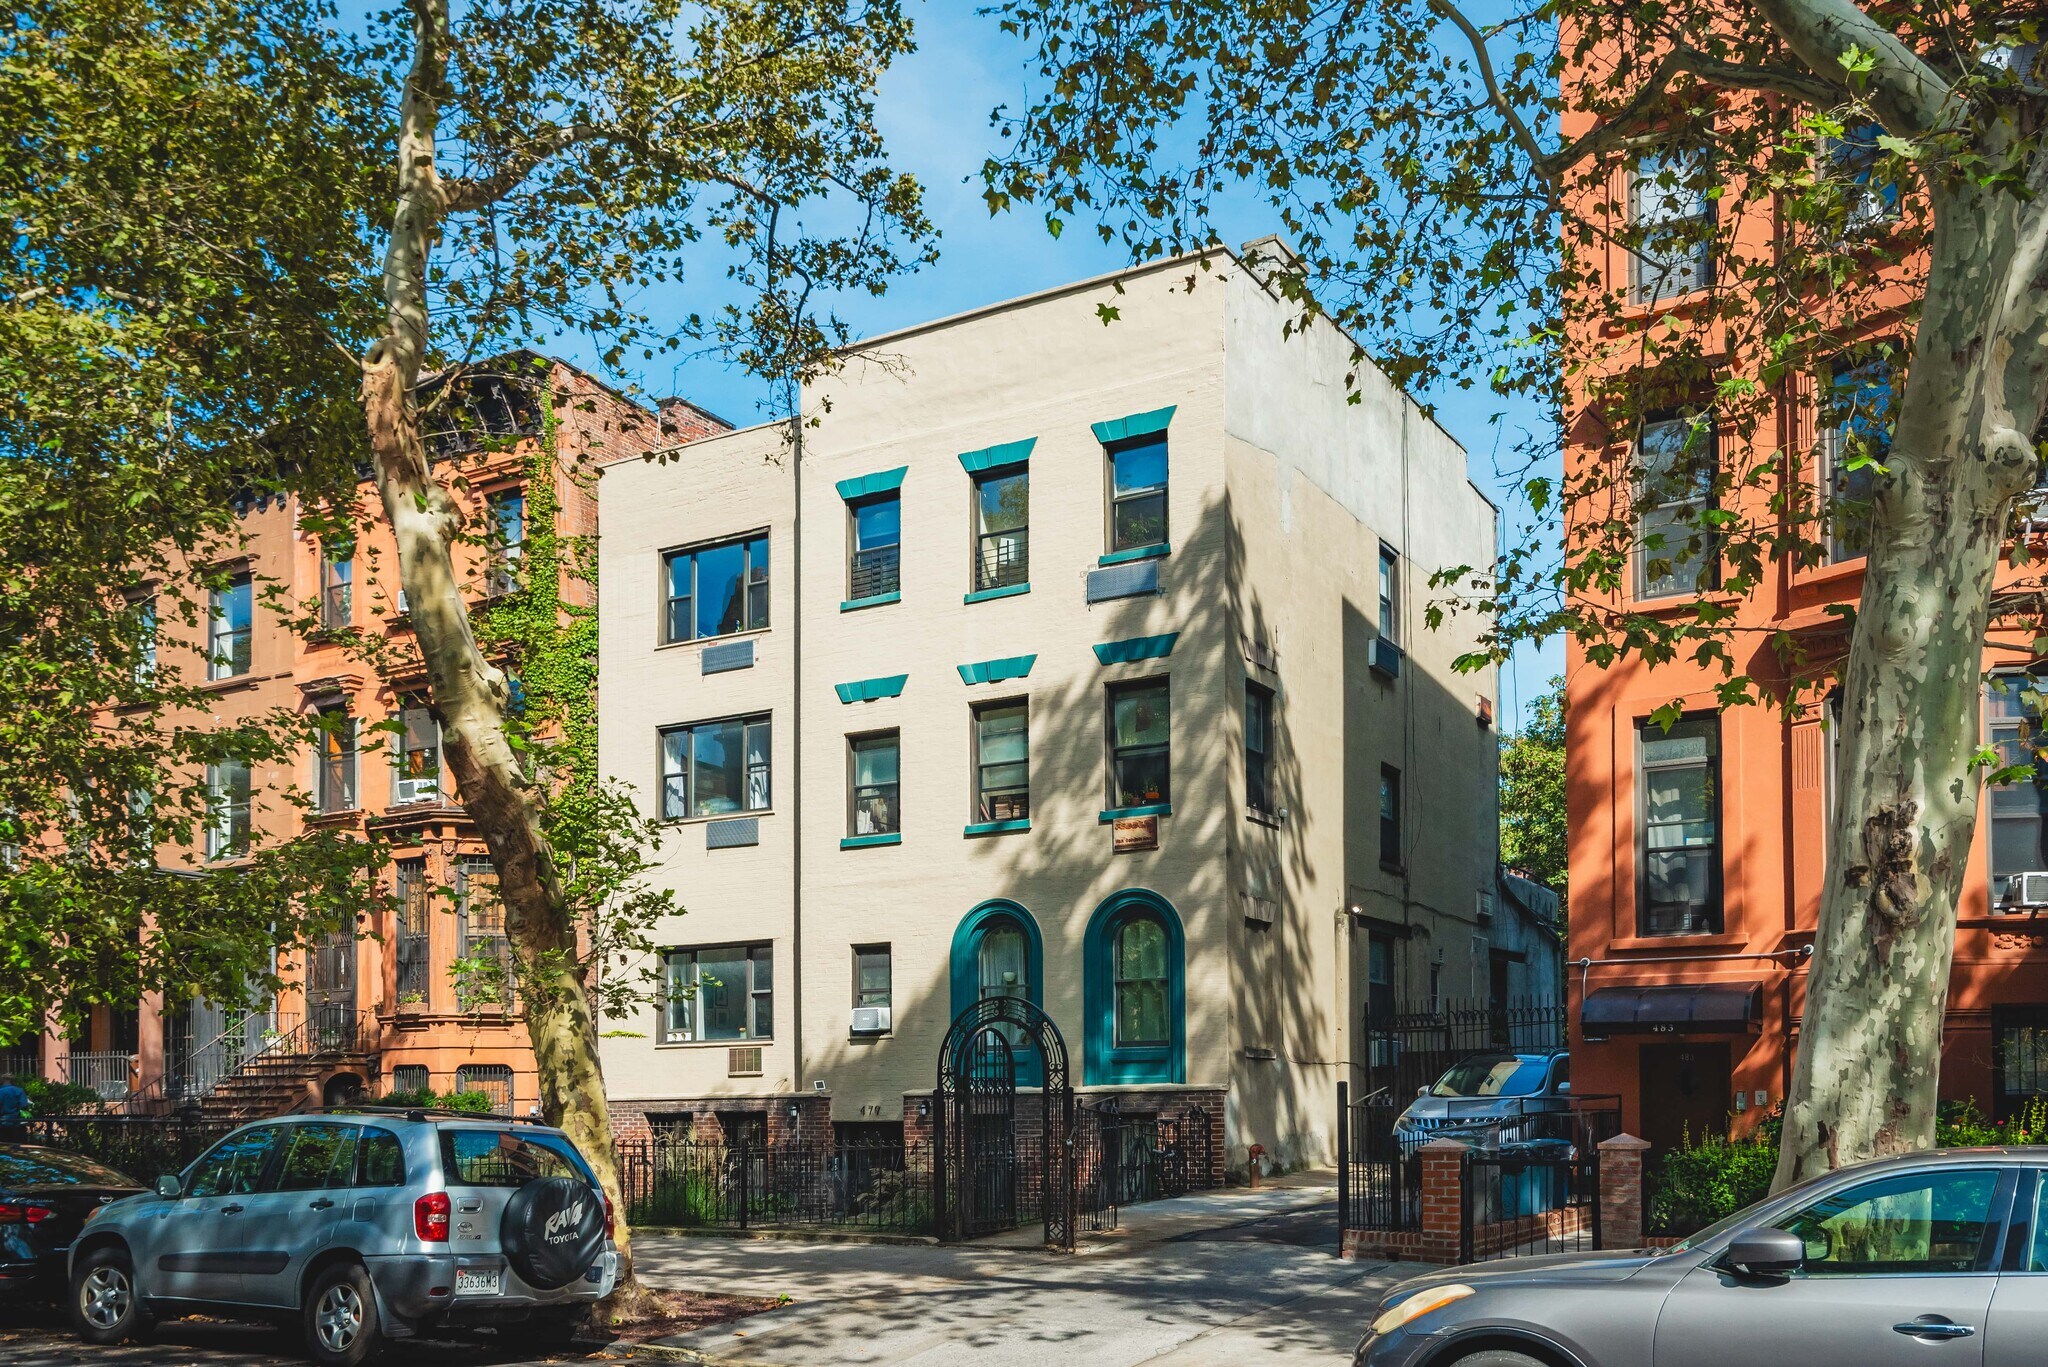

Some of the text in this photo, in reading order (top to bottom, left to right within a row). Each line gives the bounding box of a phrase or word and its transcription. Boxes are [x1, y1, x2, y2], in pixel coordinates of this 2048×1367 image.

[1652, 1024, 1674, 1032] 483
[860, 1105, 881, 1117] 479
[544, 1200, 583, 1241] RAV4
[548, 1231, 579, 1245] TOYOTA
[458, 1275, 497, 1289] 33636M3
